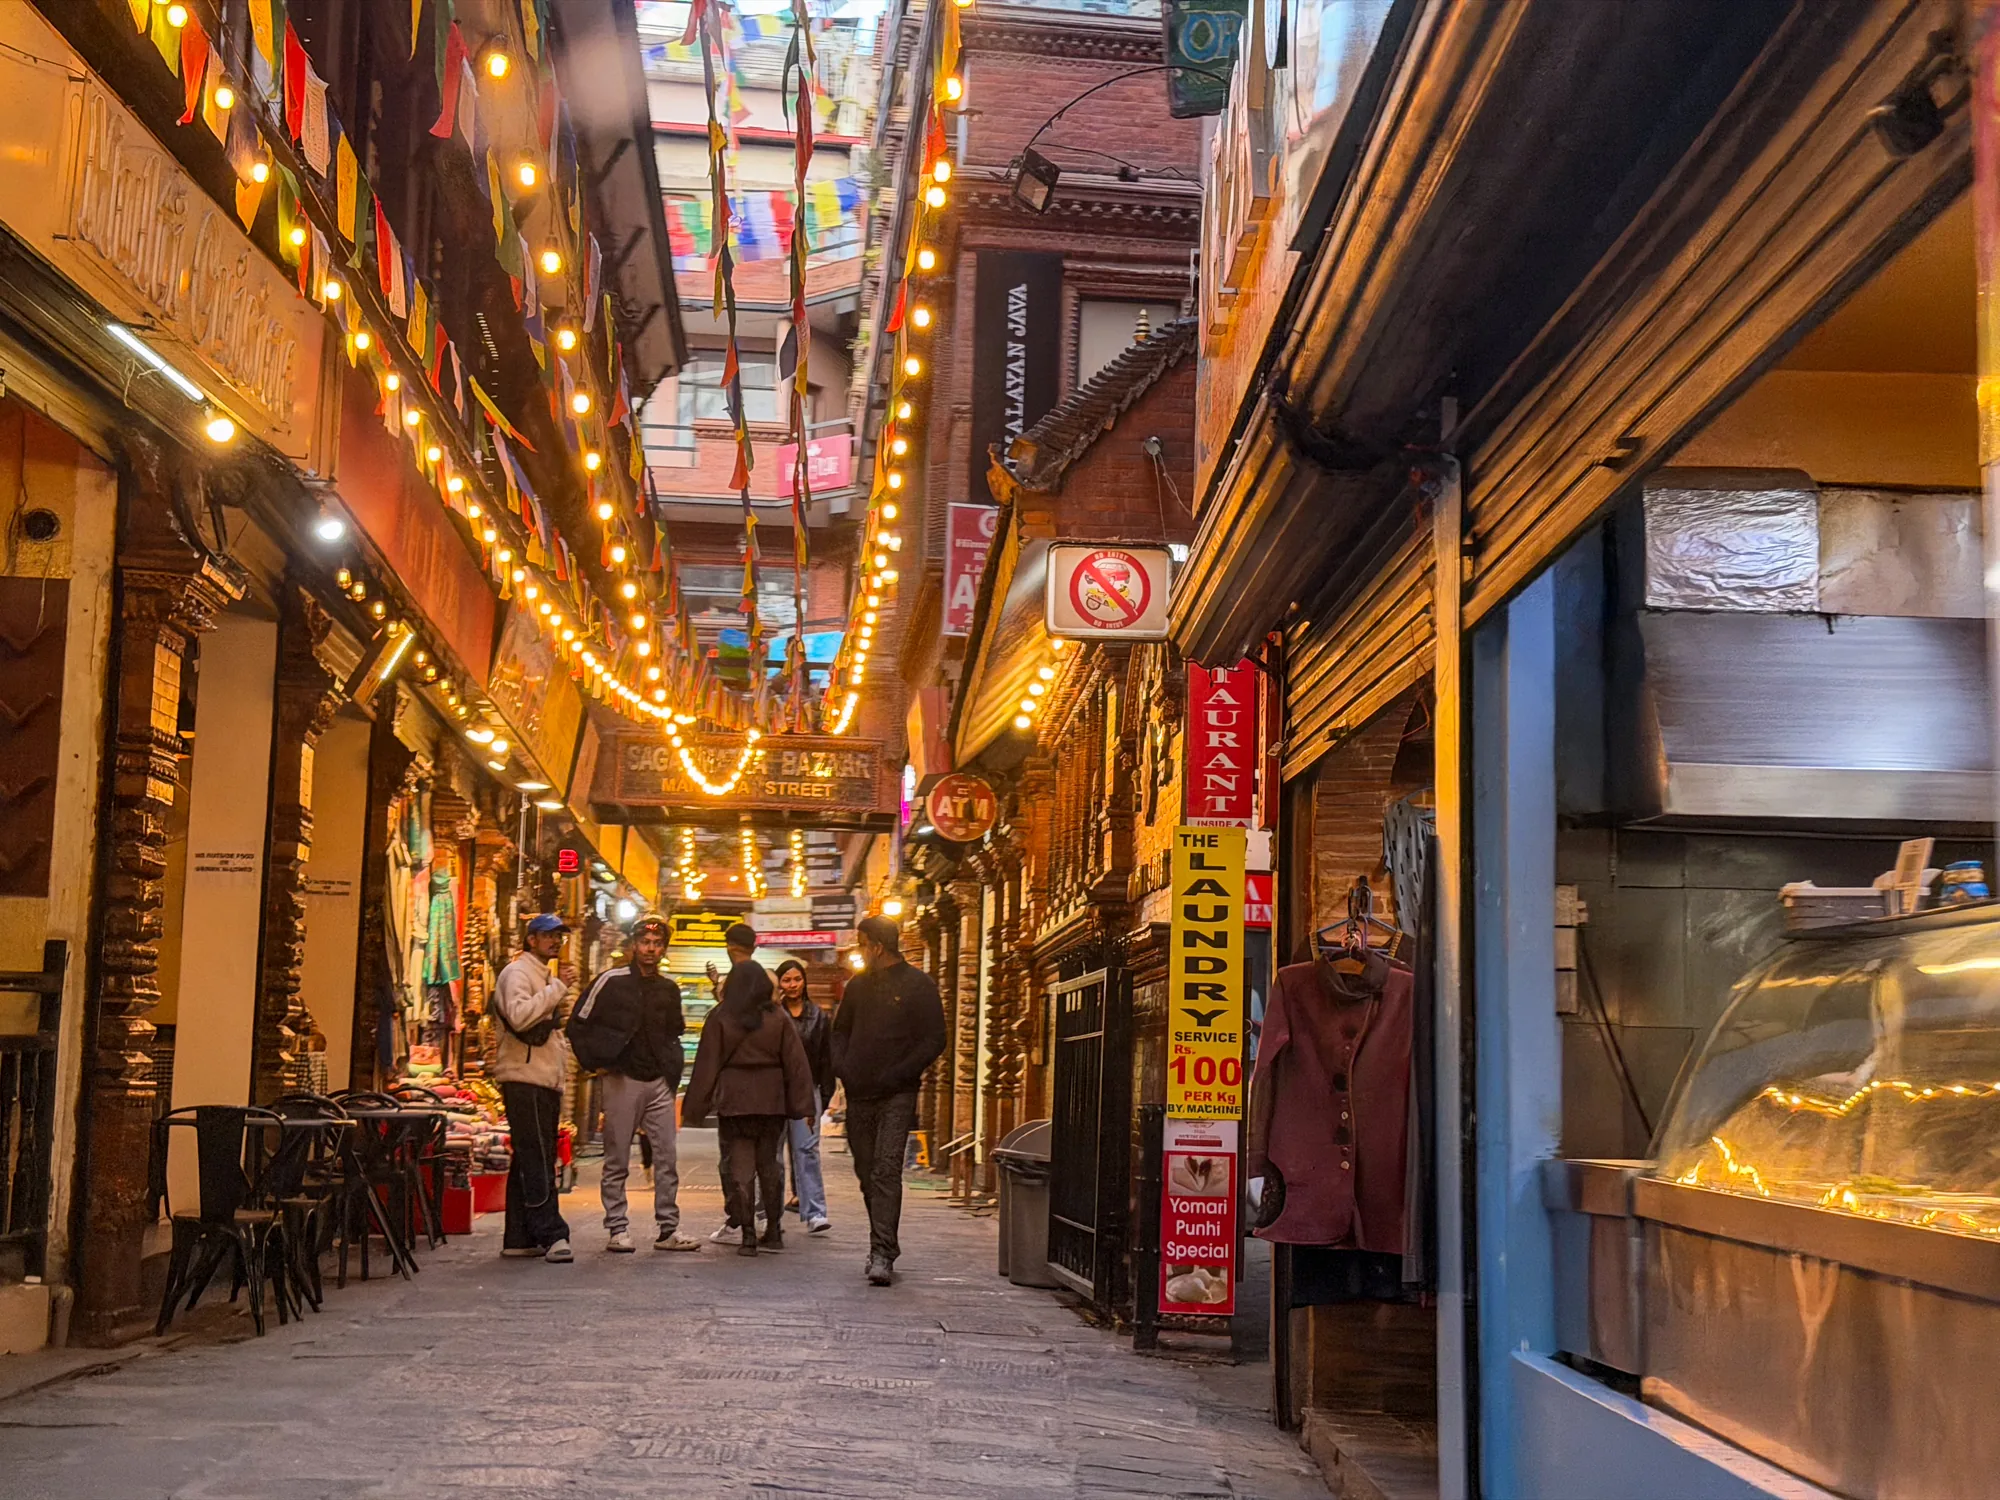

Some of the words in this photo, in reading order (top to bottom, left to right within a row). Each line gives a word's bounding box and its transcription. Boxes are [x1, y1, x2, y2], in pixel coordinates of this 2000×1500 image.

[1008, 283, 1027, 337] JAVA
[1003, 341, 1027, 472] IALAYAN
[782, 751, 870, 778] BAZAAR
[765, 781, 836, 798] STREET
[936, 795, 989, 820] ATM
[1197, 820, 1232, 828] INSIDE
[1179, 834, 1219, 848] THE
[1180, 852, 1231, 1028] LAUNDRY
[1174, 1031, 1237, 1043] SERVICE
[1174, 1044, 1196, 1055] Rs.
[1169, 1055, 1242, 1086] 100
[1184, 1091, 1212, 1102] PER
[1217, 1091, 1236, 1105] Kg
[1187, 1104, 1242, 1115] MACHINE
[1169, 1197, 1228, 1215] Yomari
[1176, 1219, 1221, 1237] Punhi
[1166, 1240, 1229, 1260] Special
